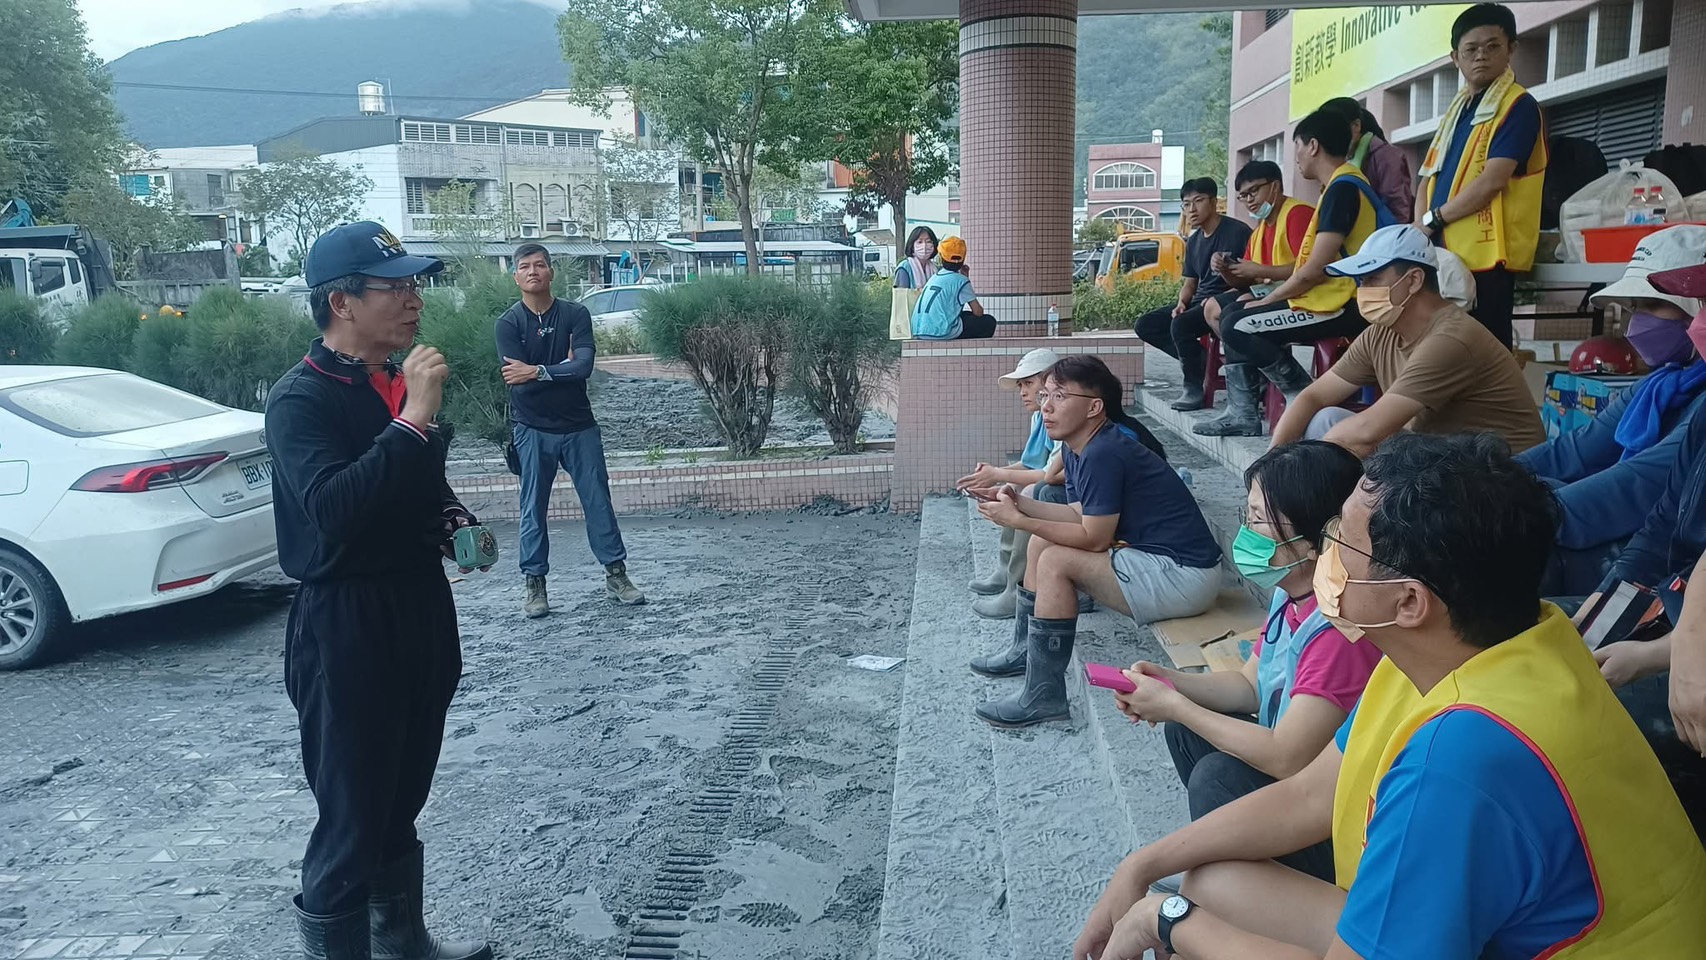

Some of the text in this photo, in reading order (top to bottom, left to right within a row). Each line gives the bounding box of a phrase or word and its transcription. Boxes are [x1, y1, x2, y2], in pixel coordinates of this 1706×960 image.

[1294, 21, 1336, 85] 創新教學
[1264, 311, 1314, 327] adidas
